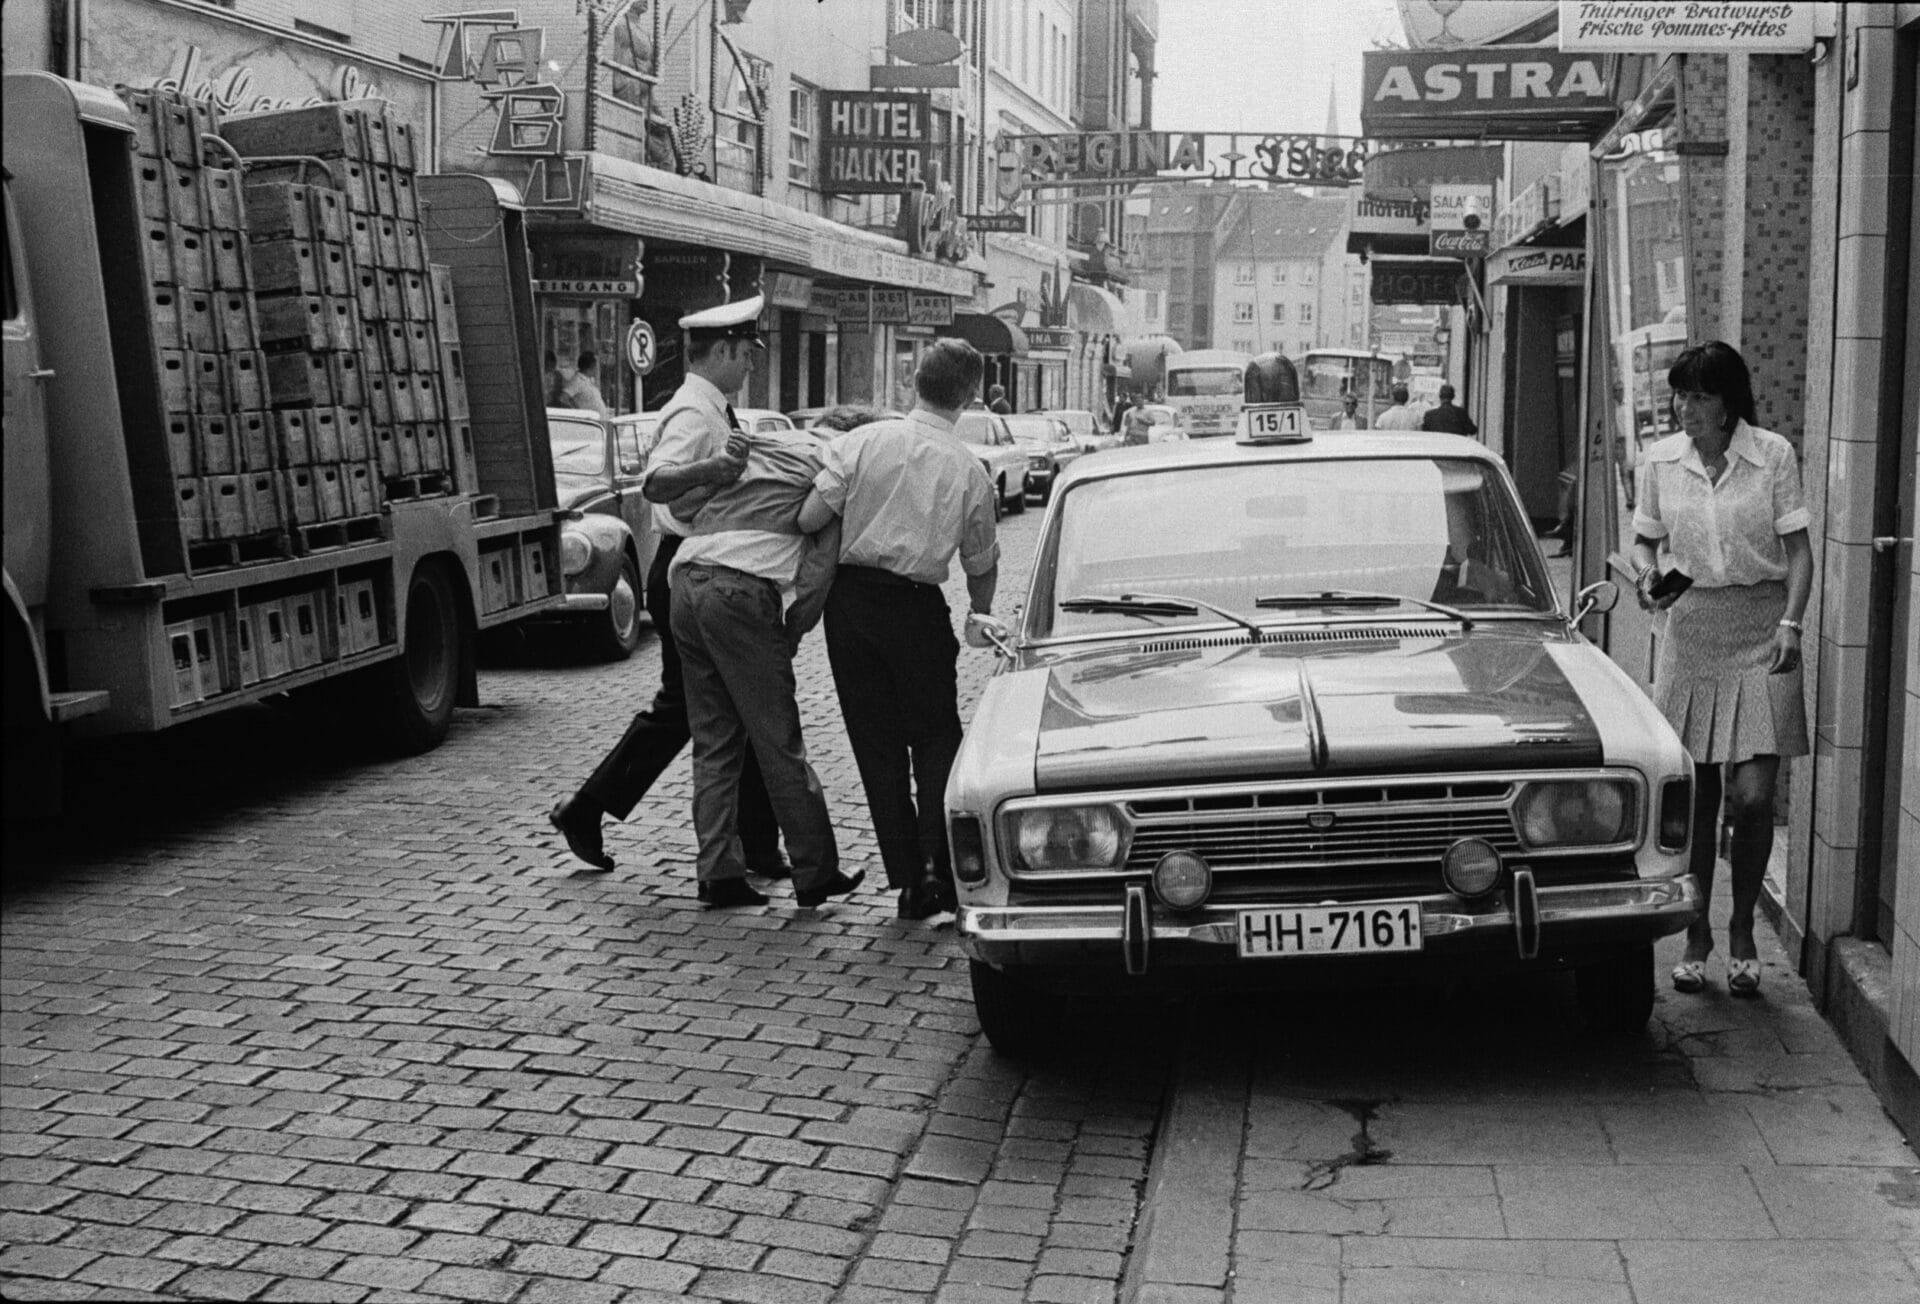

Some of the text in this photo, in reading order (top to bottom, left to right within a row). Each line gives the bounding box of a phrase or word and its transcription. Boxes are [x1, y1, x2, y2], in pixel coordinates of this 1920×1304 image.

[1580, 2, 1792, 21] Thüringer Bratwurst
[1578, 20, 1644, 38] frische
[1374, 61, 1604, 101] ASTRA
[831, 100, 921, 137] HOTEL
[1024, 134, 1204, 173] REGINA
[831, 147, 921, 183] HACKER
[1433, 195, 1490, 208] SALAO
[967, 220, 1021, 229] ASTRA
[540, 281, 628, 291] EINGANG
[1256, 413, 1295, 432] 15/1
[1244, 909, 1411, 952] HH-7161
